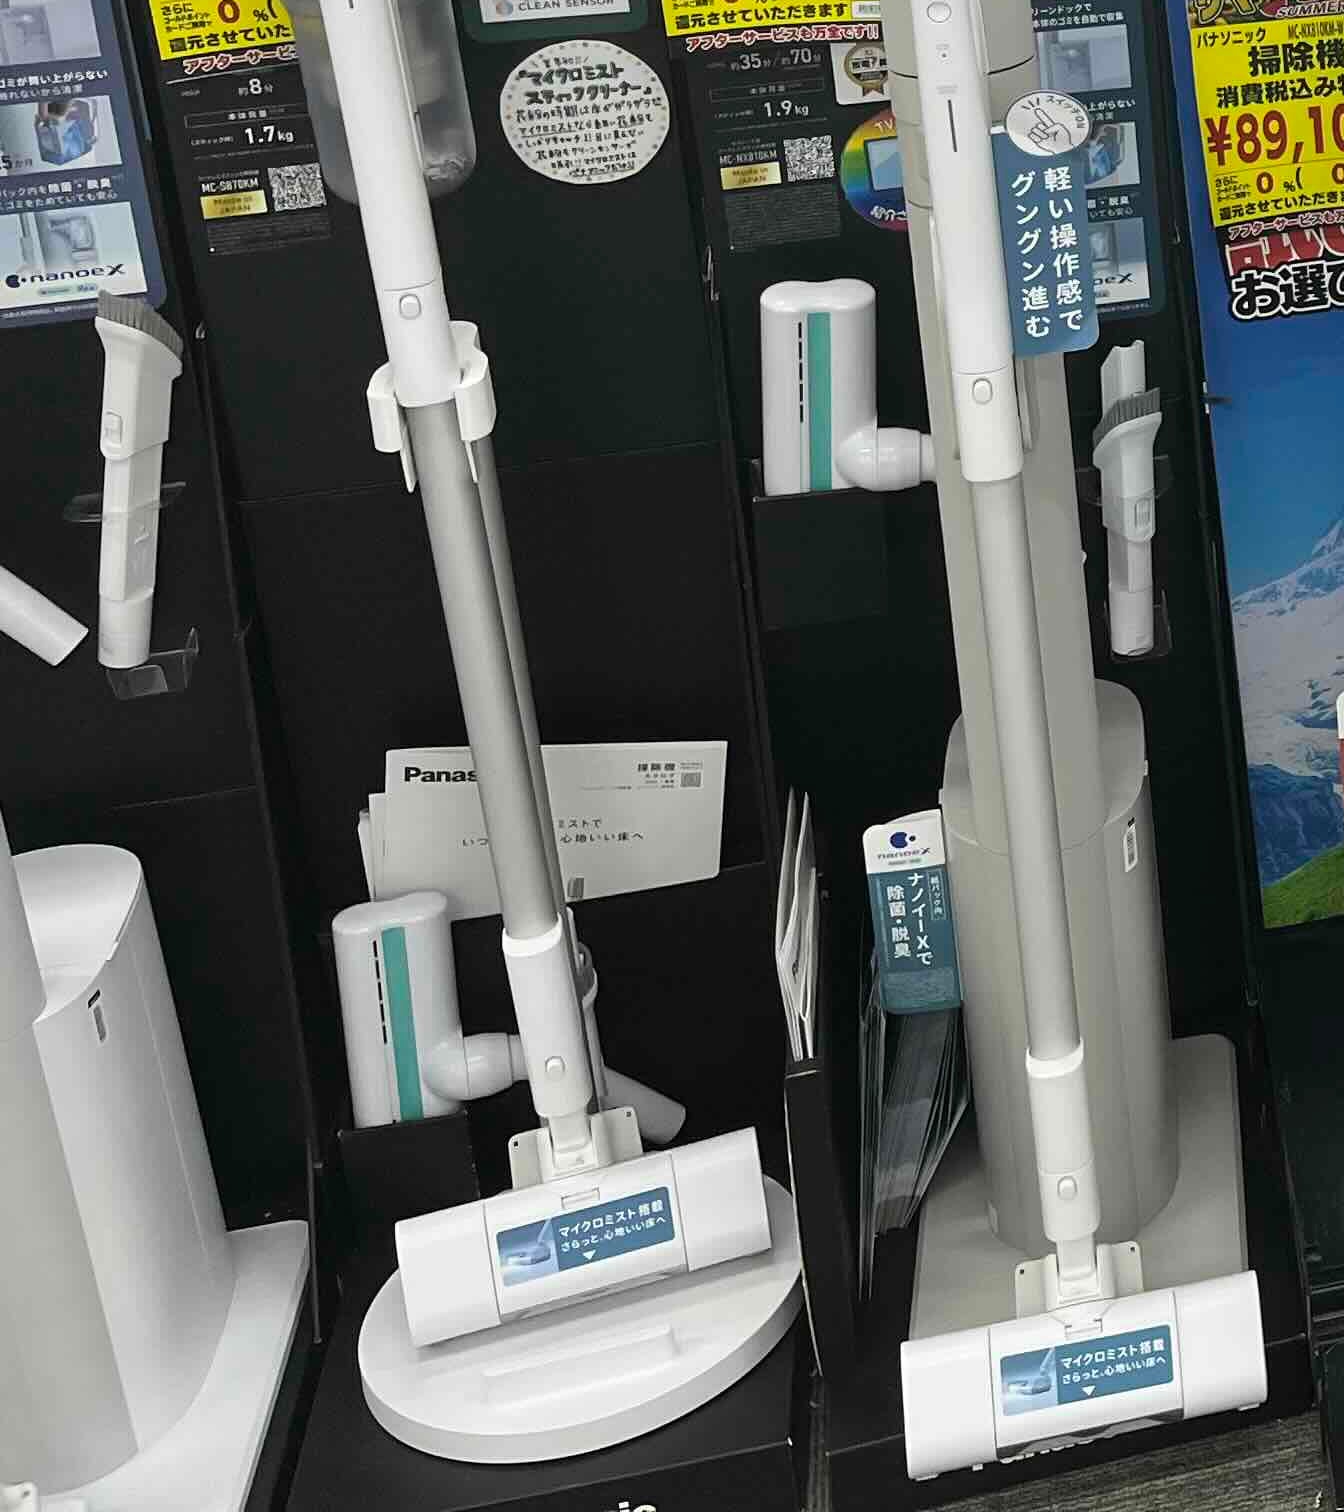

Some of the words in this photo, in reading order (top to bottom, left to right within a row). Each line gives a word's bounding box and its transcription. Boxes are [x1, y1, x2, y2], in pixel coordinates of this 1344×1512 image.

[674, 4, 848, 31] 還元させていただきます
[1196, 28, 1267, 48] パナソニック
[1010, 172, 1050, 339] グングン進む
[1043, 166, 1086, 333] 軽い操作感で
[886, 884, 911, 960] 除菌・脱臭
[908, 872, 934, 966] ナノイーXで
[558, 1198, 665, 1239] マイクロミスト搭載
[1059, 1336, 1166, 1368] マイクロミスト搭載
